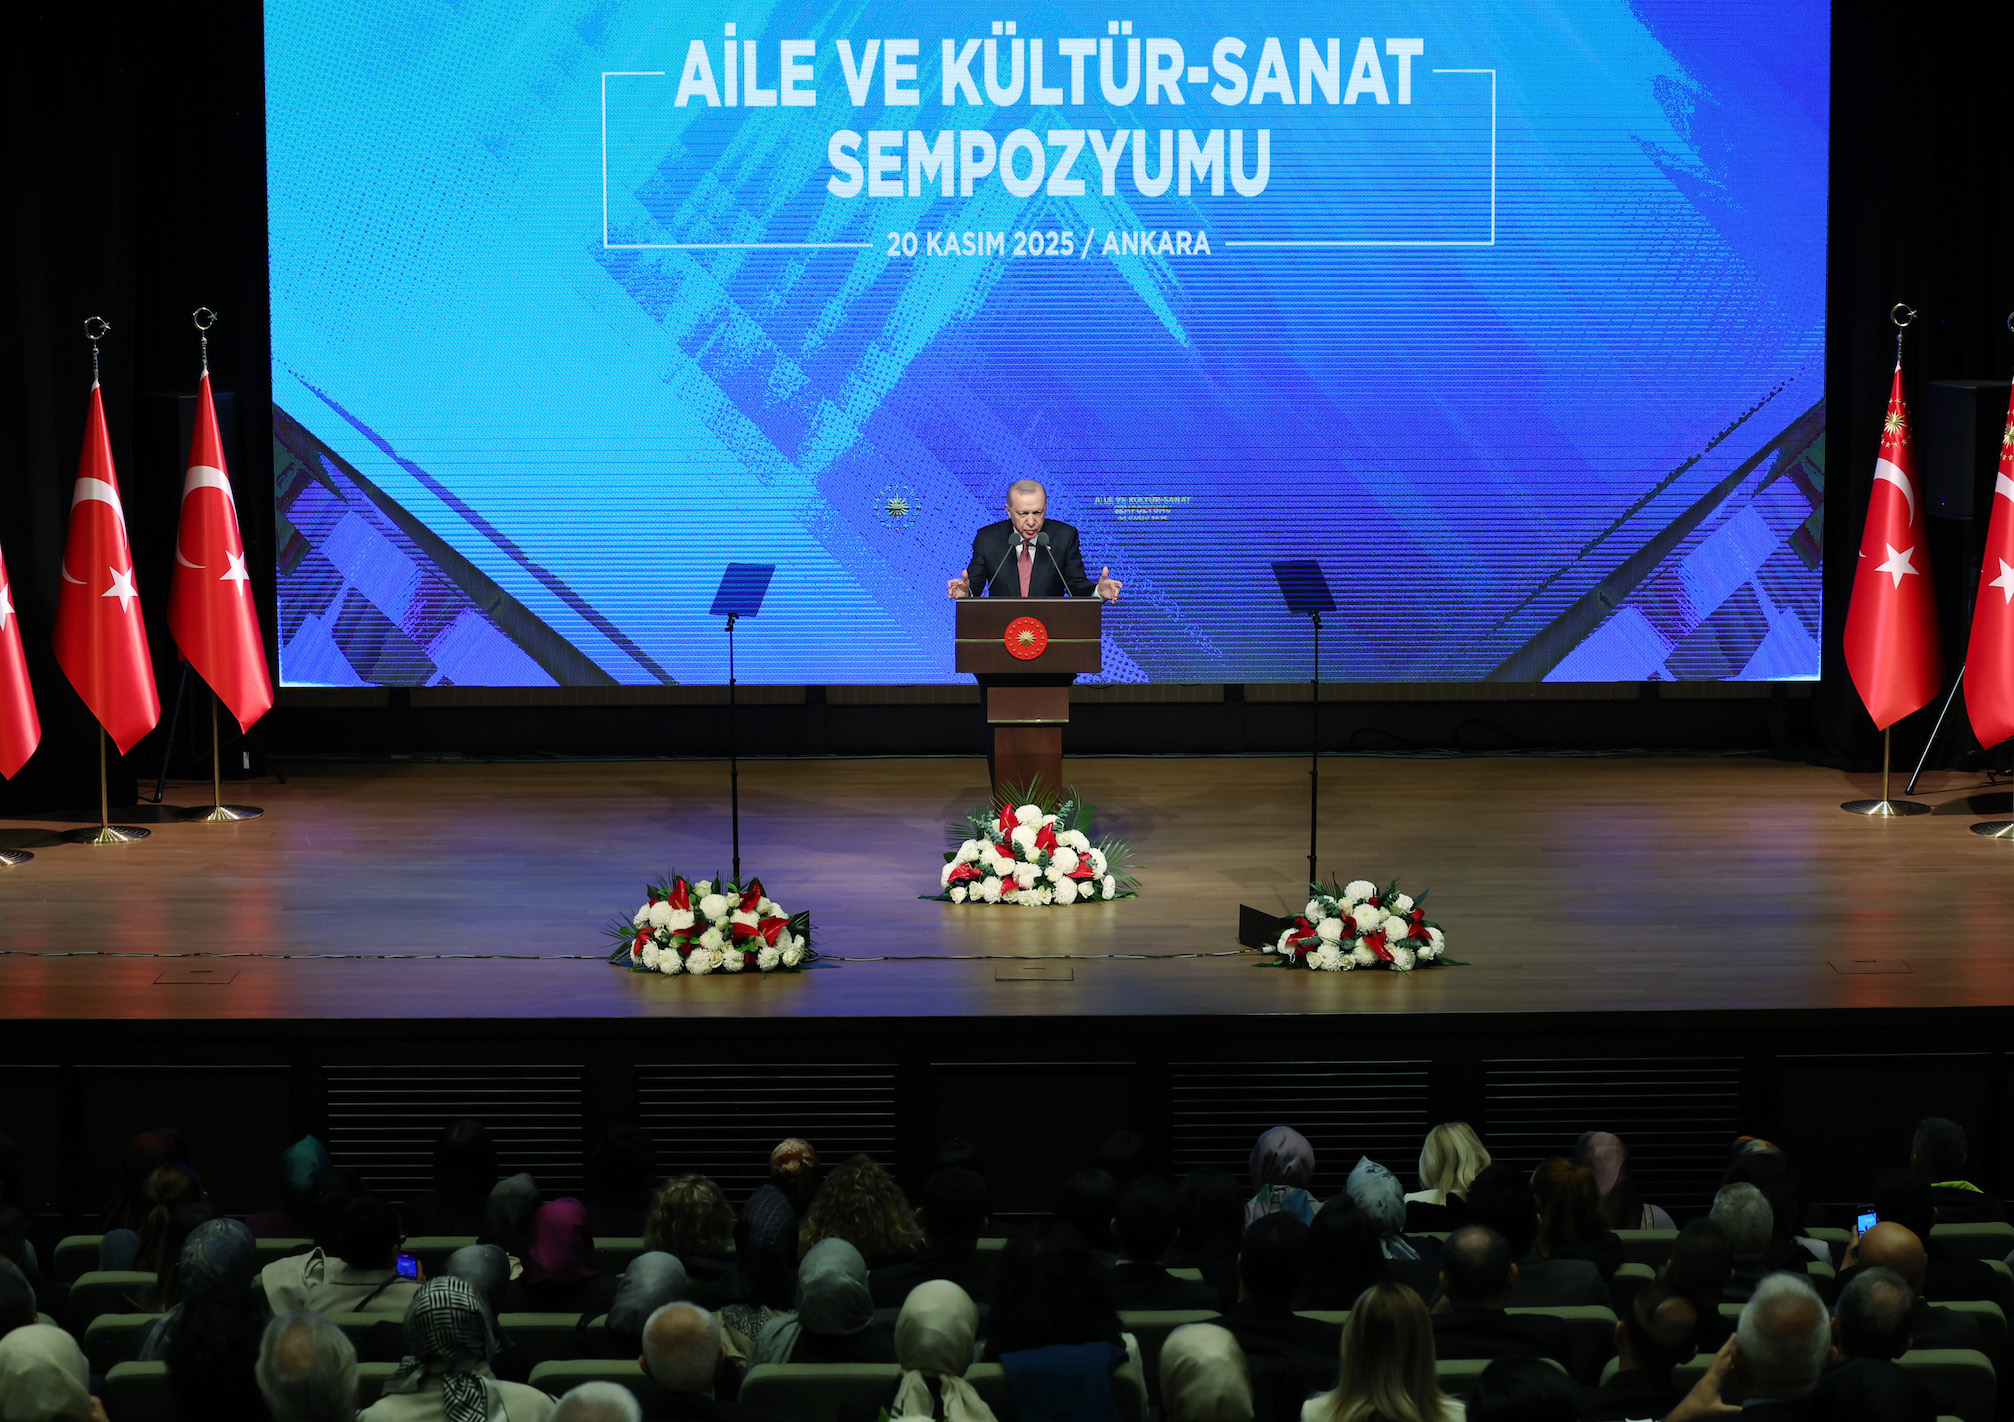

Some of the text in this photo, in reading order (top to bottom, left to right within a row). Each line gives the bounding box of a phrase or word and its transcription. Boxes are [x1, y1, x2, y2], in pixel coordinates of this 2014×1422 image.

[675, 20, 1424, 107] AİLE VE KÜLTÜR-SANAT
[827, 128, 1271, 199] SEMPOZYUMU
[887, 228, 1211, 261] 20 KASIM 2025 / ANKARA
